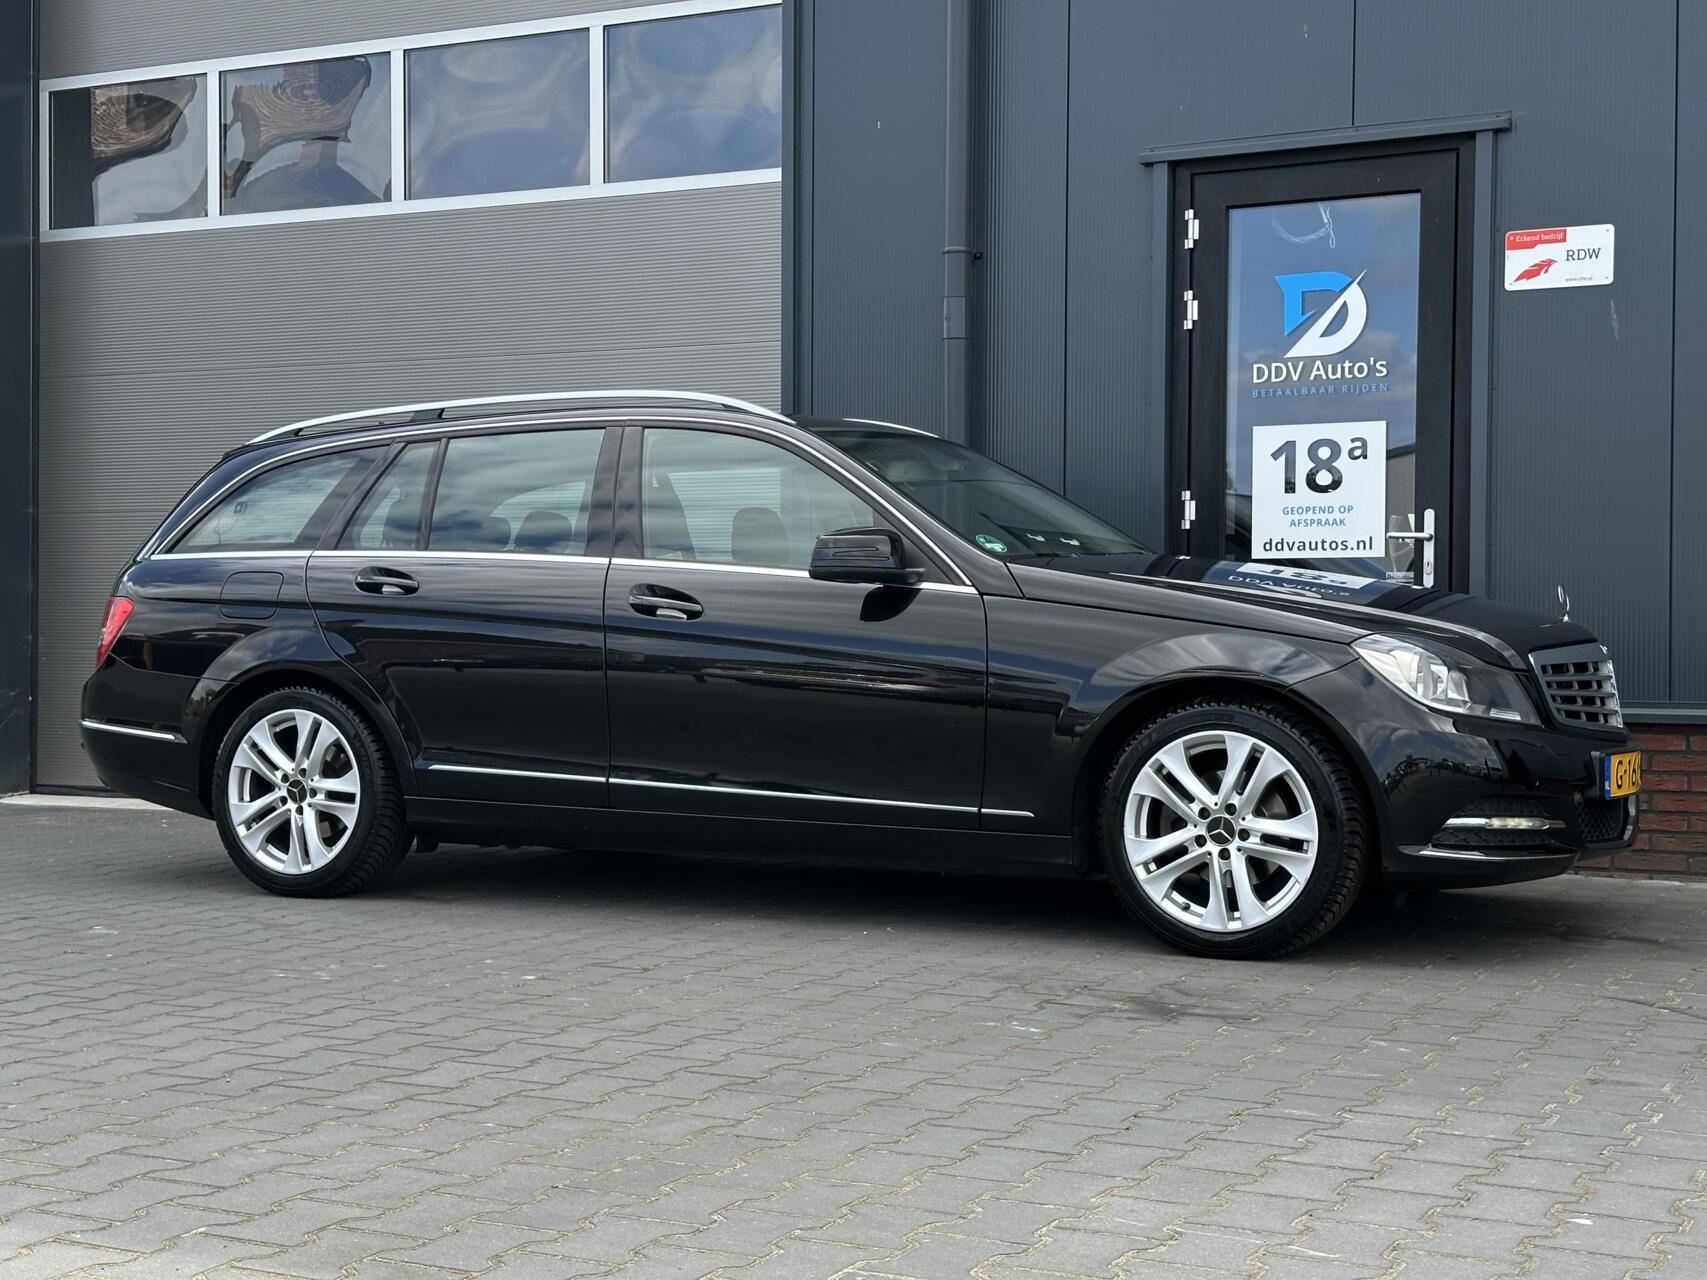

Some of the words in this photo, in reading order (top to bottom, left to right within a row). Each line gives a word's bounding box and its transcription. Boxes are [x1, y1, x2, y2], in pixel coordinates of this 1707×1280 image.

[1515, 233, 1540, 243] Erkend
[1541, 231, 1564, 241] bedrijf
[1565, 247, 1602, 262] RDW
[1252, 362, 1304, 383] DDV
[1309, 357, 1387, 380] Auto's
[1251, 385, 1335, 398] BETAALBAAR
[1342, 382, 1389, 395] RIJDEN
[1270, 436, 1368, 494] 18a
[1282, 505, 1335, 516] GEOPEND
[1338, 504, 1354, 514] OP
[1289, 517, 1346, 528] AFSPRAAK
[1263, 536, 1373, 552] ddvautos.nl
[1615, 758, 1640, 789] G-16
